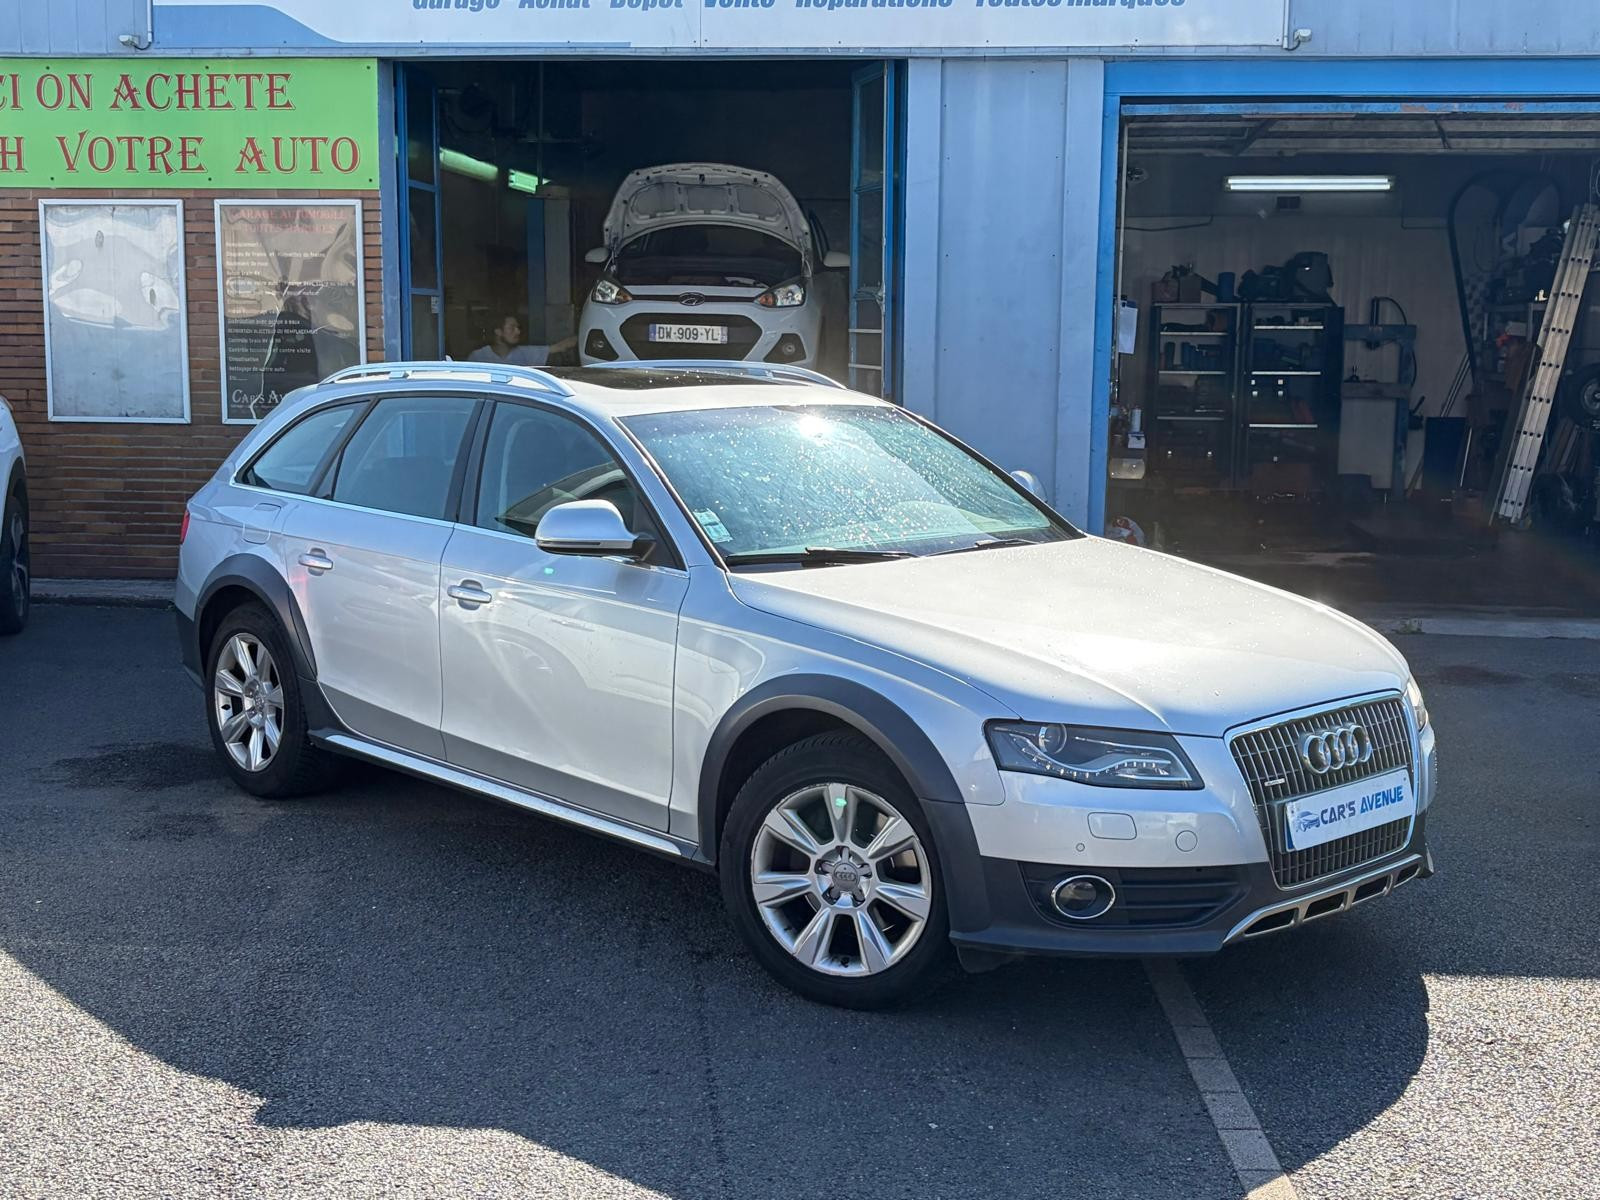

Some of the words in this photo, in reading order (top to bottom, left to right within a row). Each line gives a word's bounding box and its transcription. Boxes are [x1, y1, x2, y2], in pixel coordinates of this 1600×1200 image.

[36, 73, 94, 111] ON
[108, 73, 295, 111] ACHETE
[56, 130, 208, 175] VOTRE
[234, 136, 361, 174] AUTO
[1321, 801, 1356, 825] CAR'S
[1360, 785, 1404, 814] AVENUE
